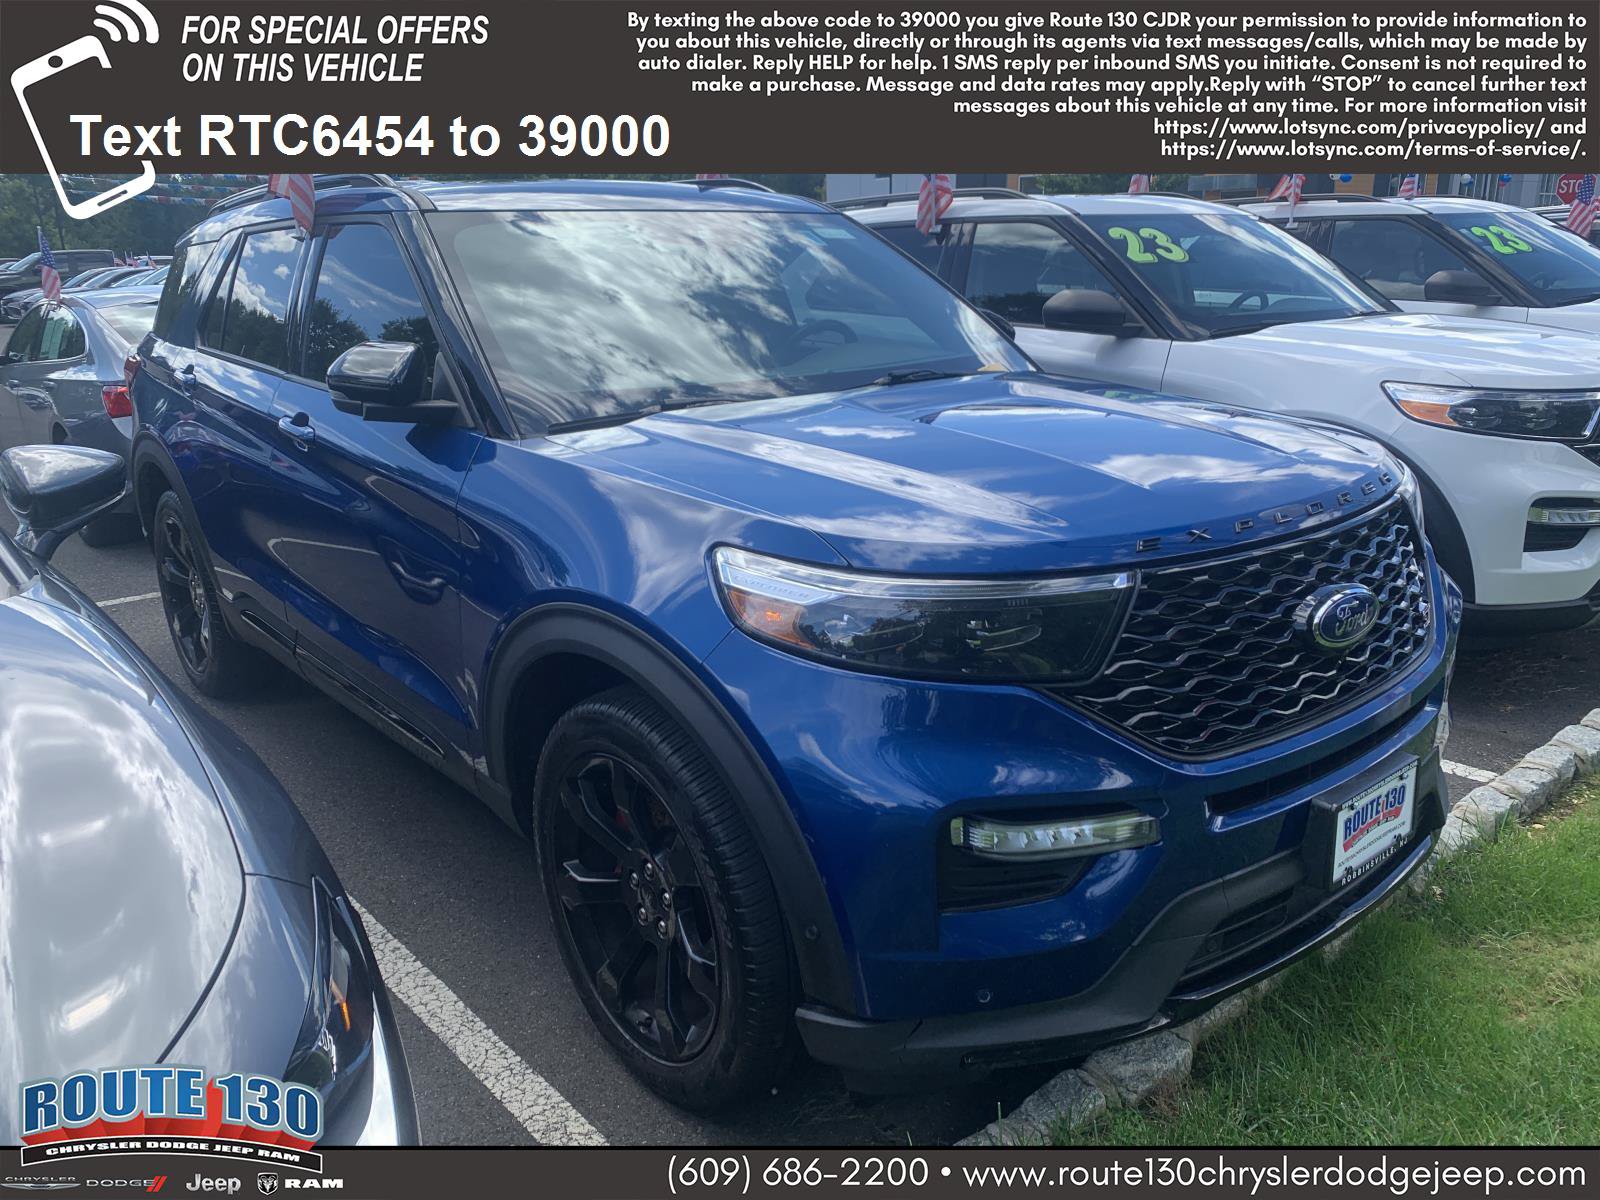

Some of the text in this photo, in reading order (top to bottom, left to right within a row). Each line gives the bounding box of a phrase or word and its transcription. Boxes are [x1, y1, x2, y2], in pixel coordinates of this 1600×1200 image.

[1559, 179, 1584, 194] STO
[1108, 227, 1189, 263] 23
[1471, 225, 1533, 254] 23
[1136, 471, 1392, 553] EXPLORER
[1335, 600, 1369, 636] Ford
[1344, 793, 1382, 841] ROUTE
[1385, 784, 1406, 811] 130
